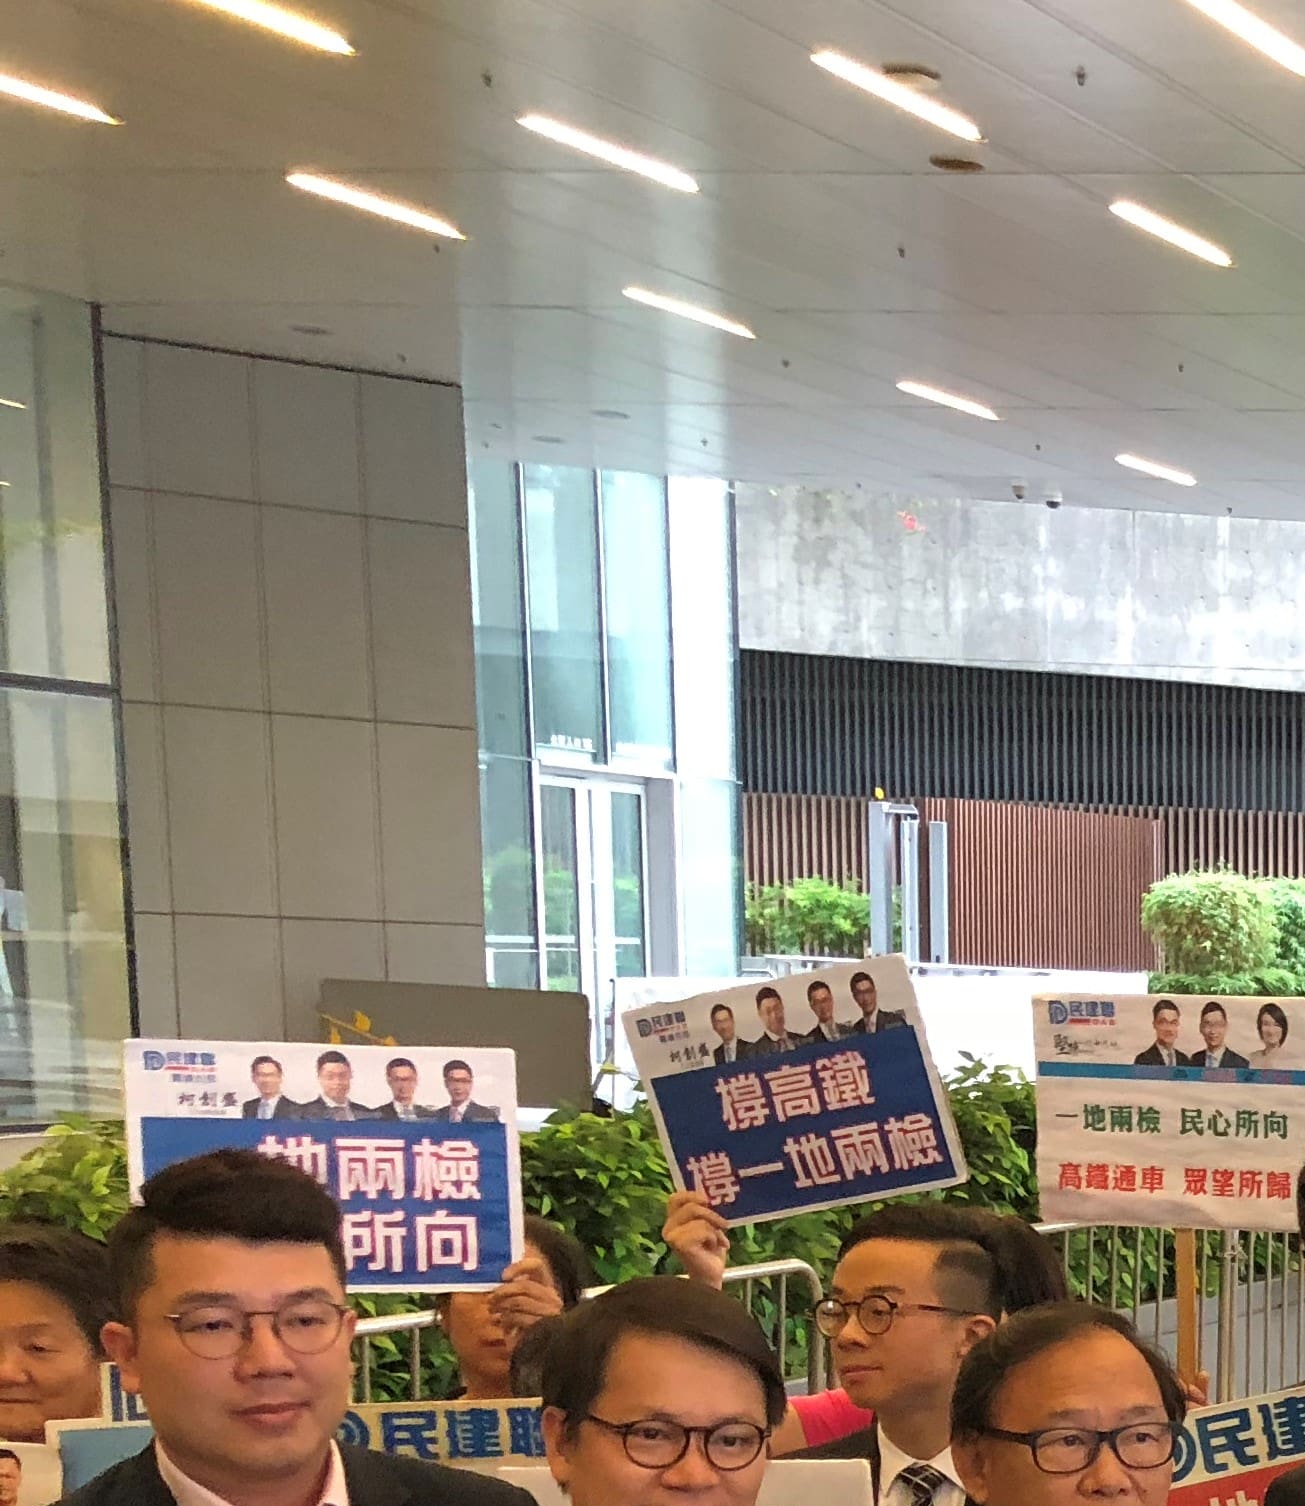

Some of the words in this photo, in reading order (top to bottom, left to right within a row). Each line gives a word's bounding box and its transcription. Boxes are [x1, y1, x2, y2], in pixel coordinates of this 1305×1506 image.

[714, 1051, 875, 1132] 撐高鐵
[1055, 1104, 1161, 1133] 一地兩檢
[1180, 1108, 1288, 1139] 民心所向
[687, 1113, 944, 1206] 撐一地兩檢
[1058, 1163, 1165, 1193] 高鐵通車
[1183, 1167, 1292, 1200] 眾望所歸
[343, 1210, 478, 1273] 所向
